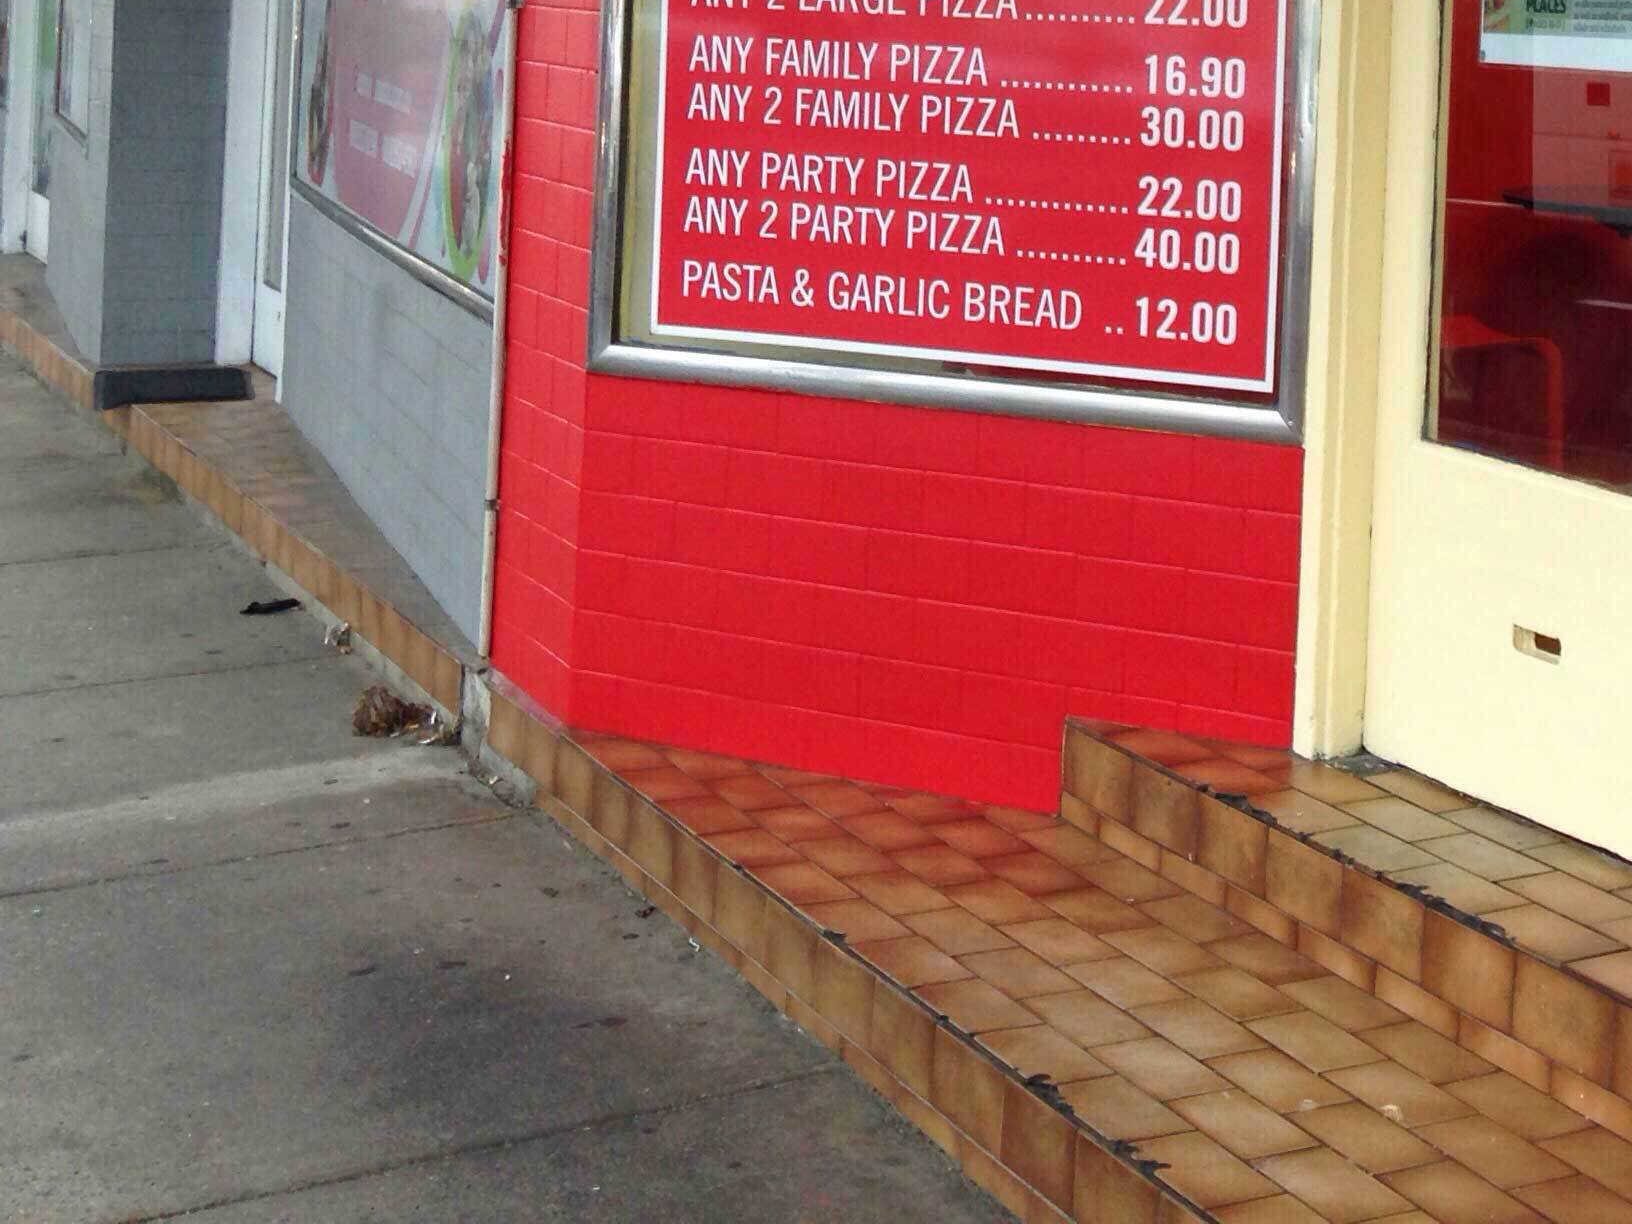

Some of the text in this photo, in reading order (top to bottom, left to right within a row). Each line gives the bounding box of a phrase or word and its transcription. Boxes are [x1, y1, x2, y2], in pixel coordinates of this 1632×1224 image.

[688, 35, 1246, 99] ANY FAMILY PIZZA 16.90
[687, 83, 1244, 151] ANY 2 FAMILY PIZZA 30.00
[685, 147, 1242, 223] ANY PARTY PIZZA 22.00
[683, 195, 1239, 275] ANY 2 PARTY PIZZA 40.00
[682, 260, 1237, 346] PASTA & GARLIC BREAD 12.00
